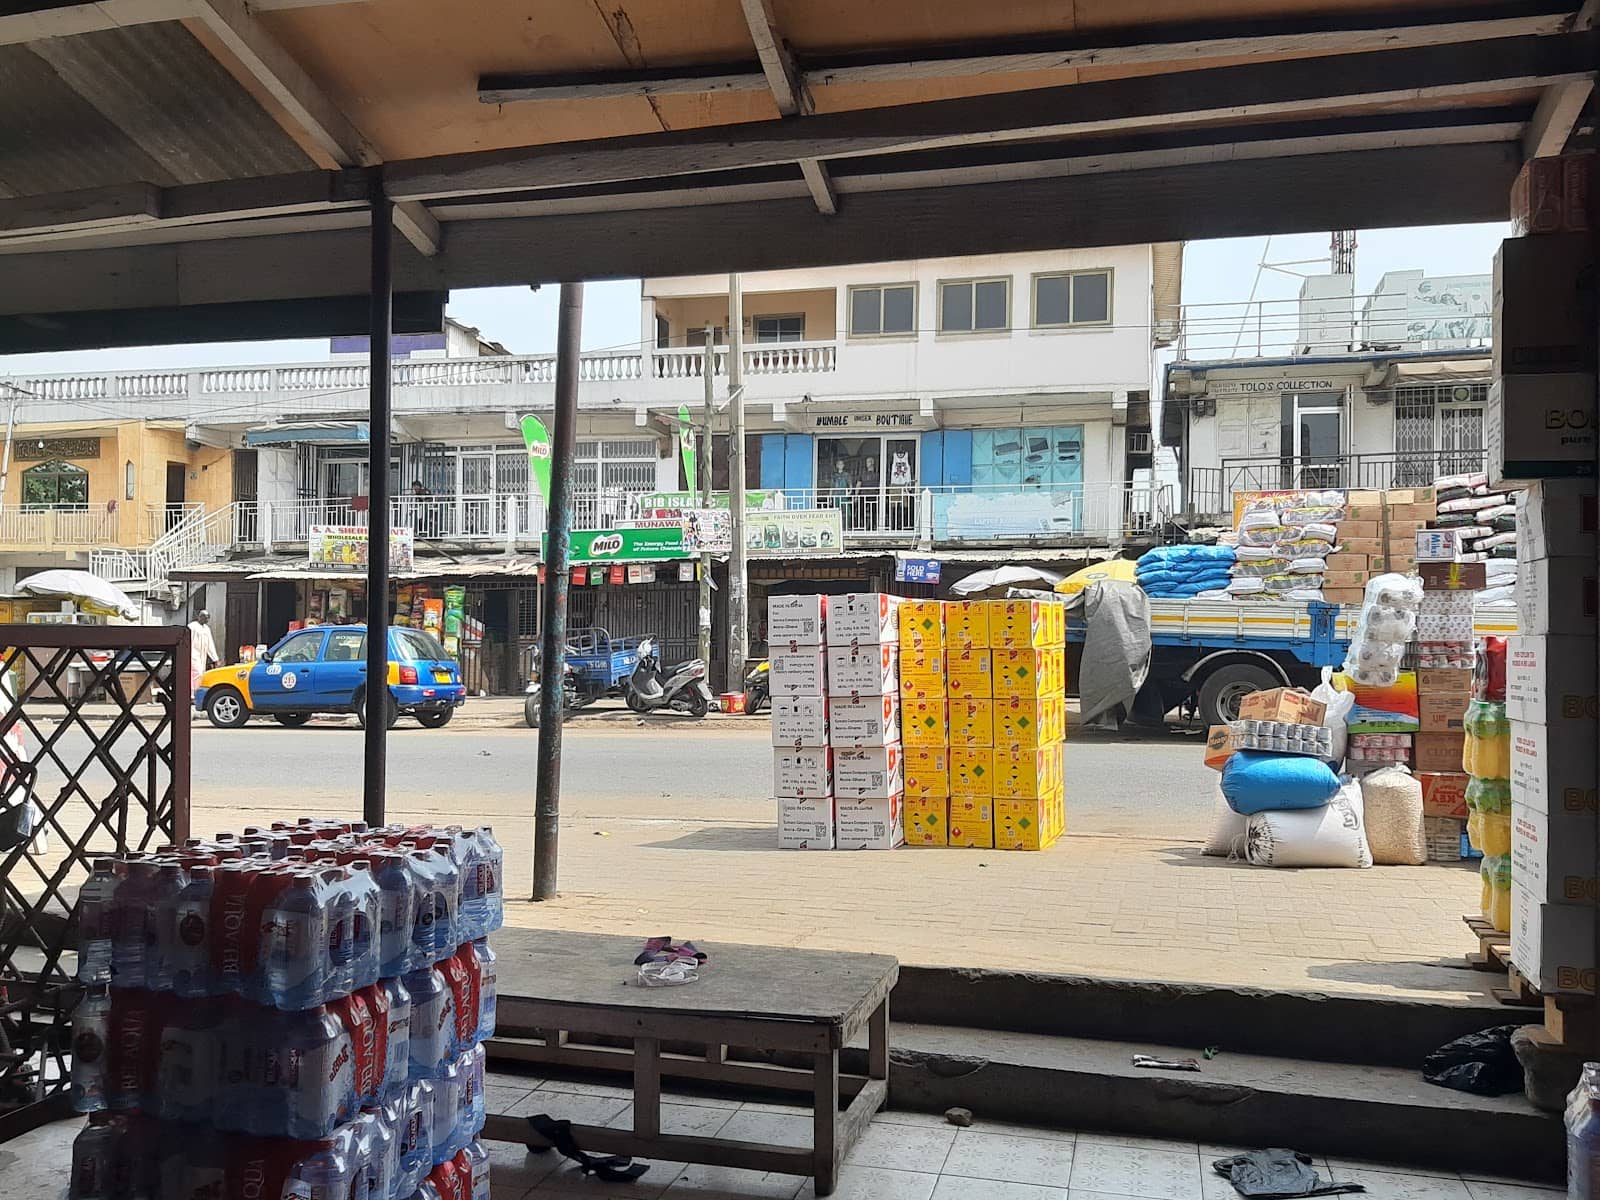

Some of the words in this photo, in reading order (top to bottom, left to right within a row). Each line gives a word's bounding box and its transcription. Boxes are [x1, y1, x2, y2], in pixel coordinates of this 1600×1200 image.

[1276, 380, 1333, 391] COLLECTION
[876, 413, 914, 425] BOUTIQUE
[593, 539, 621, 552] MILO
